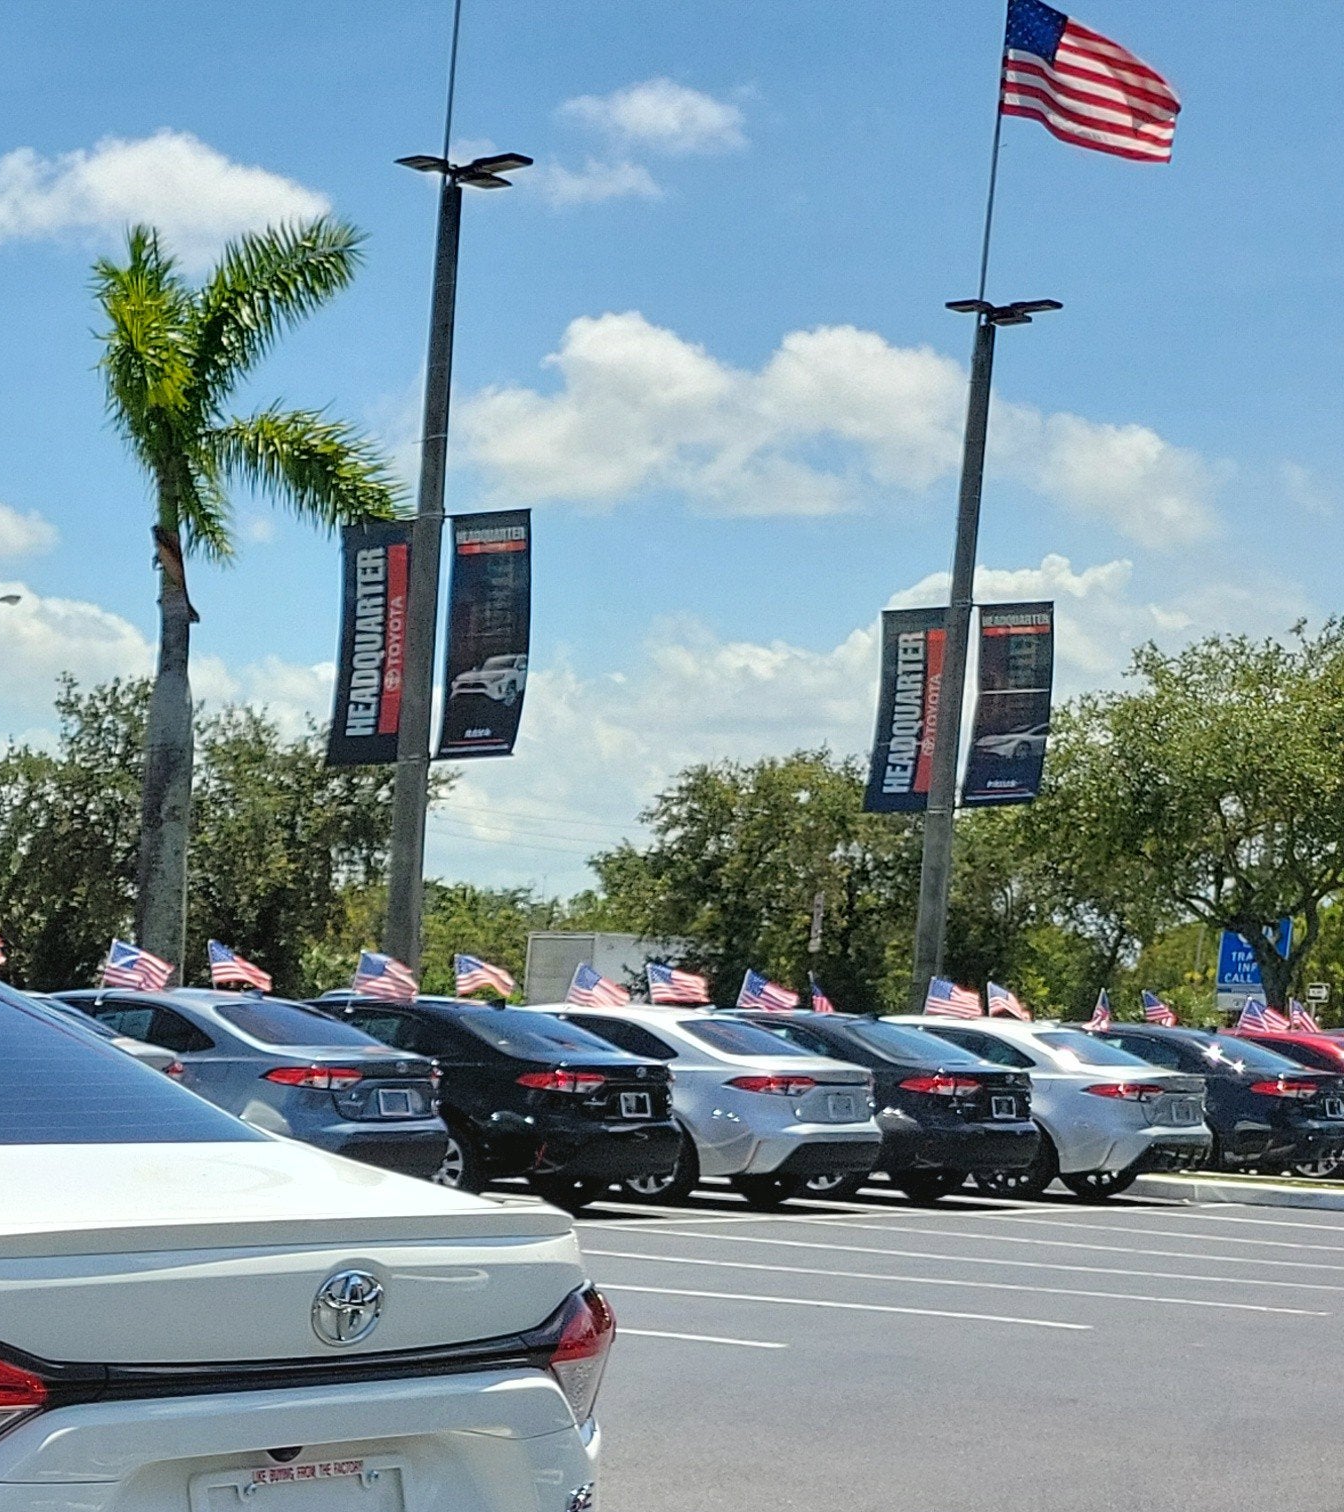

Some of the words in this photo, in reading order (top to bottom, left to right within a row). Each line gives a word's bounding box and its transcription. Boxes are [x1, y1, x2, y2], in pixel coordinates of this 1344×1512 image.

[345, 547, 387, 737] HEADQUARTER
[386, 596, 404, 670] TOYOTA
[881, 630, 927, 795] HEADQUARTER
[1224, 972, 1253, 983] CALL
